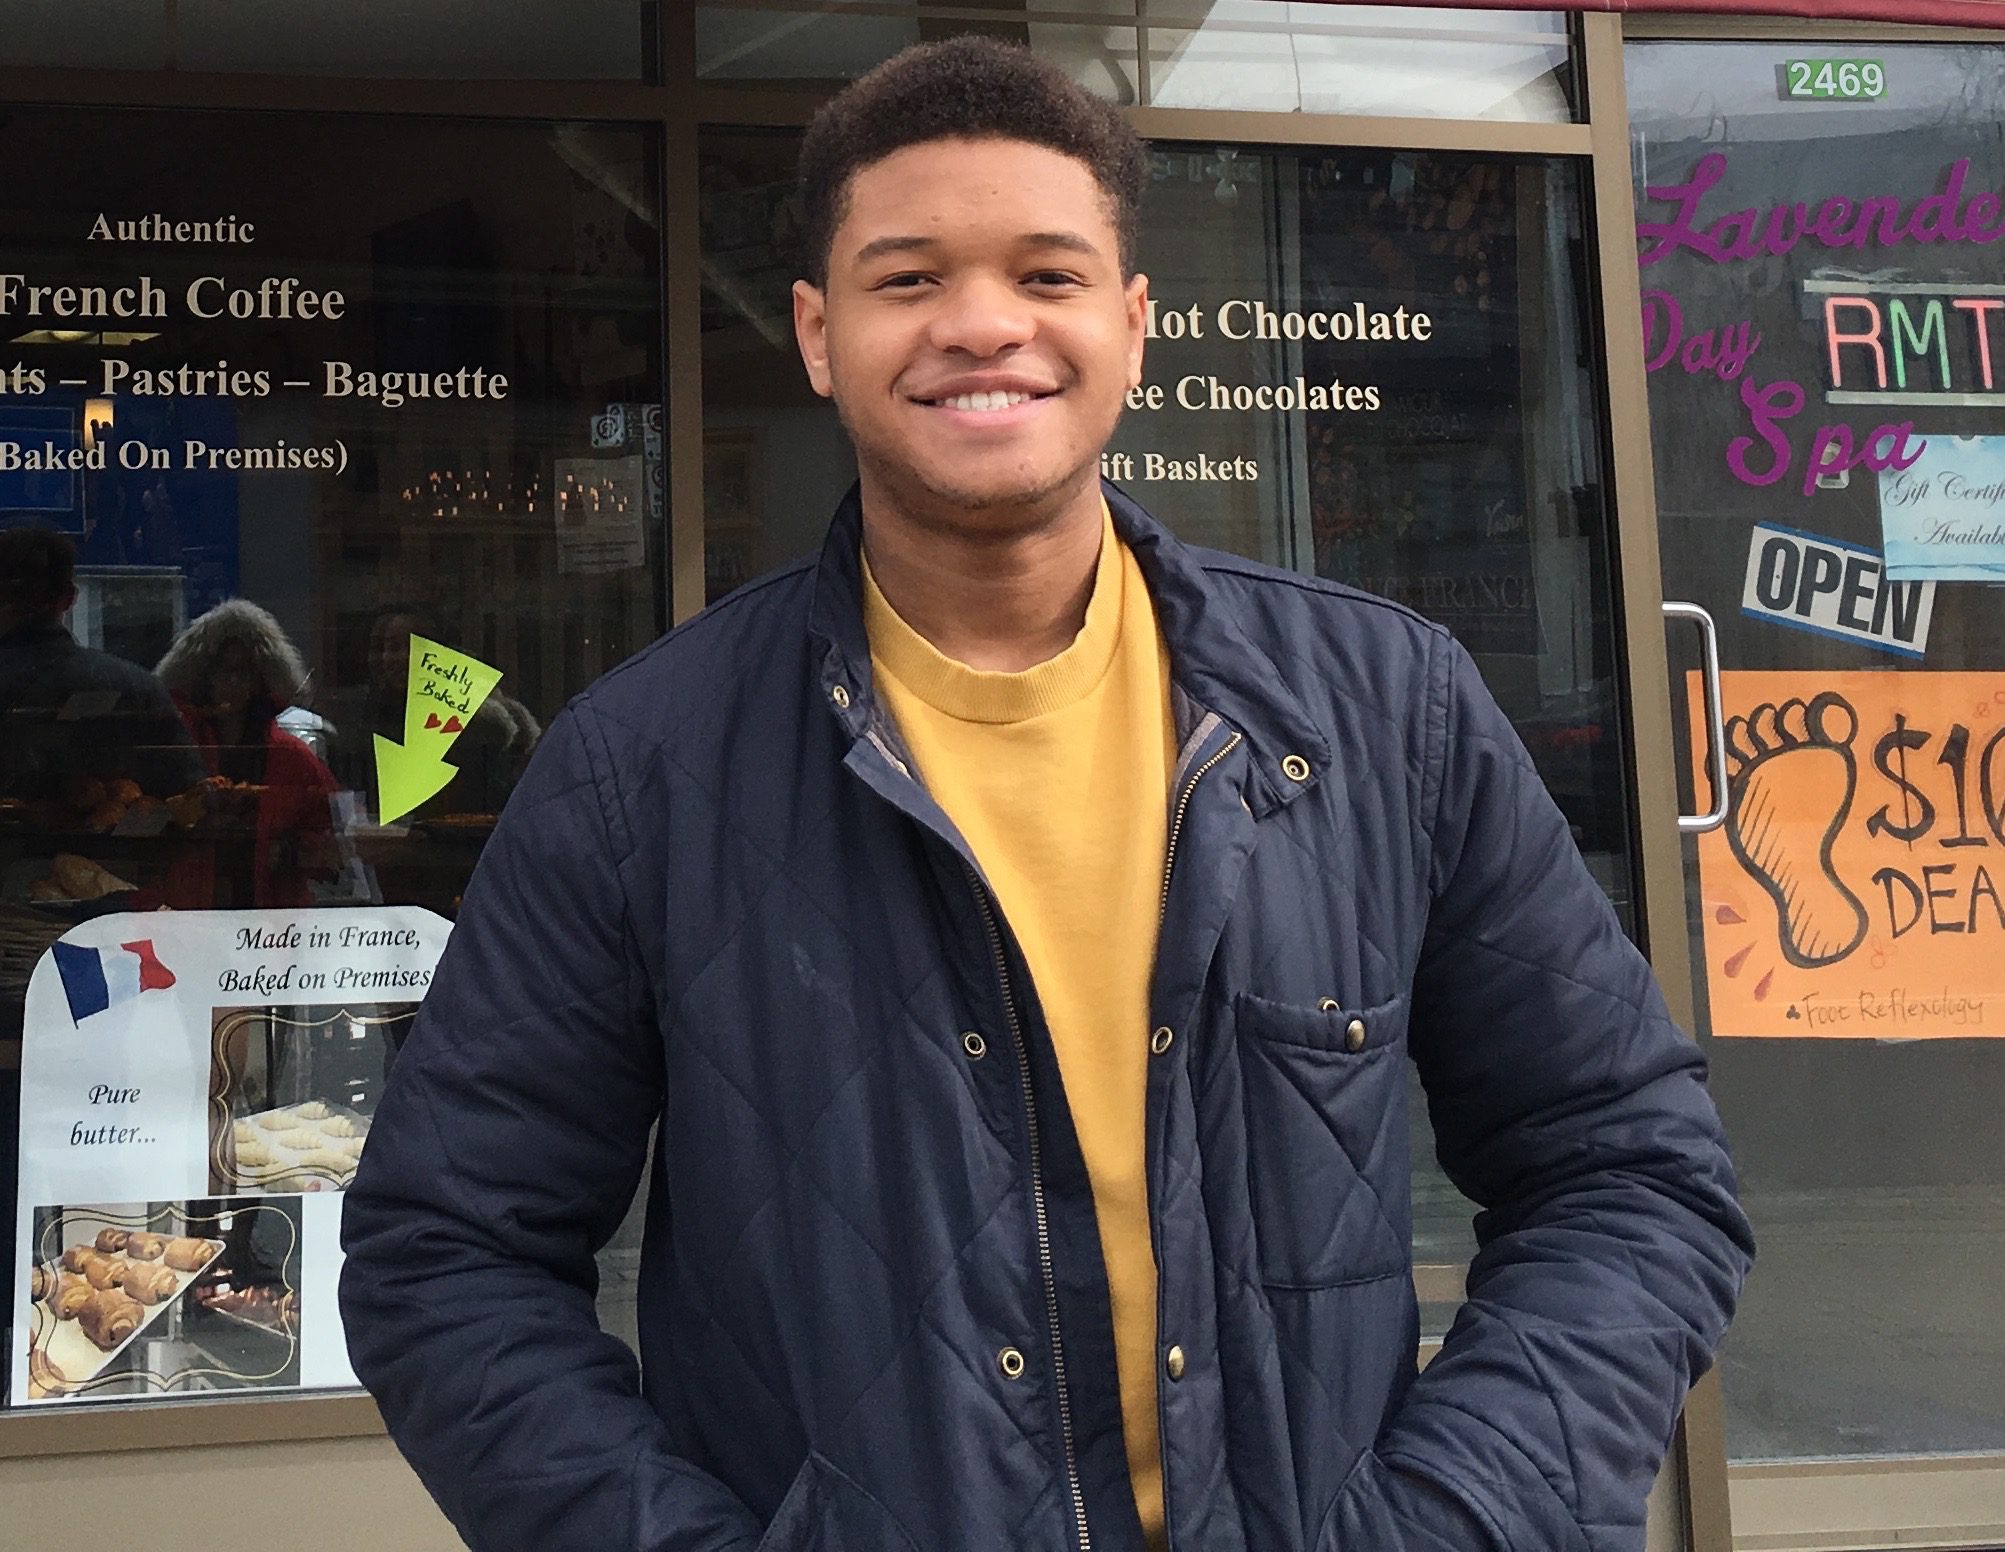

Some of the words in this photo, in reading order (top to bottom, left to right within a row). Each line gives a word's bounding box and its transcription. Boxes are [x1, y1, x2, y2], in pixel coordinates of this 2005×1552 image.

[1790, 62, 1885, 98] 2469
[88, 213, 256, 244] Authentic
[1635, 152, 2005, 268] Lavende
[0, 274, 168, 318] French
[187, 276, 346, 321] Coffee
[1217, 299, 1432, 341] Chocolate
[1639, 288, 1762, 380] Day
[1825, 296, 2005, 388] RMT
[0, 360, 46, 395] ts
[101, 359, 271, 398] Pastries
[324, 361, 509, 408] Baguette
[1175, 375, 1381, 411] Chocolates
[1726, 376, 1927, 495] Spa
[118, 440, 171, 471] On
[184, 440, 349, 476] Premises)
[1143, 453, 1259, 481] Baskets
[1885, 471, 1931, 507] Gift
[1756, 537, 1923, 643] OPEN
[421, 652, 474, 696] Freshly
[416, 680, 470, 715] Baked
[1872, 863, 2005, 939] DEA
[236, 923, 302, 951] Made
[309, 925, 331, 949] in
[339, 926, 421, 950] France,
[218, 964, 298, 997] Baked
[298, 972, 326, 990] on
[334, 964, 431, 989] Premises
[1859, 986, 1984, 1025] Reflexology
[88, 1085, 141, 1107] Pure
[69, 1121, 157, 1147] butter...
